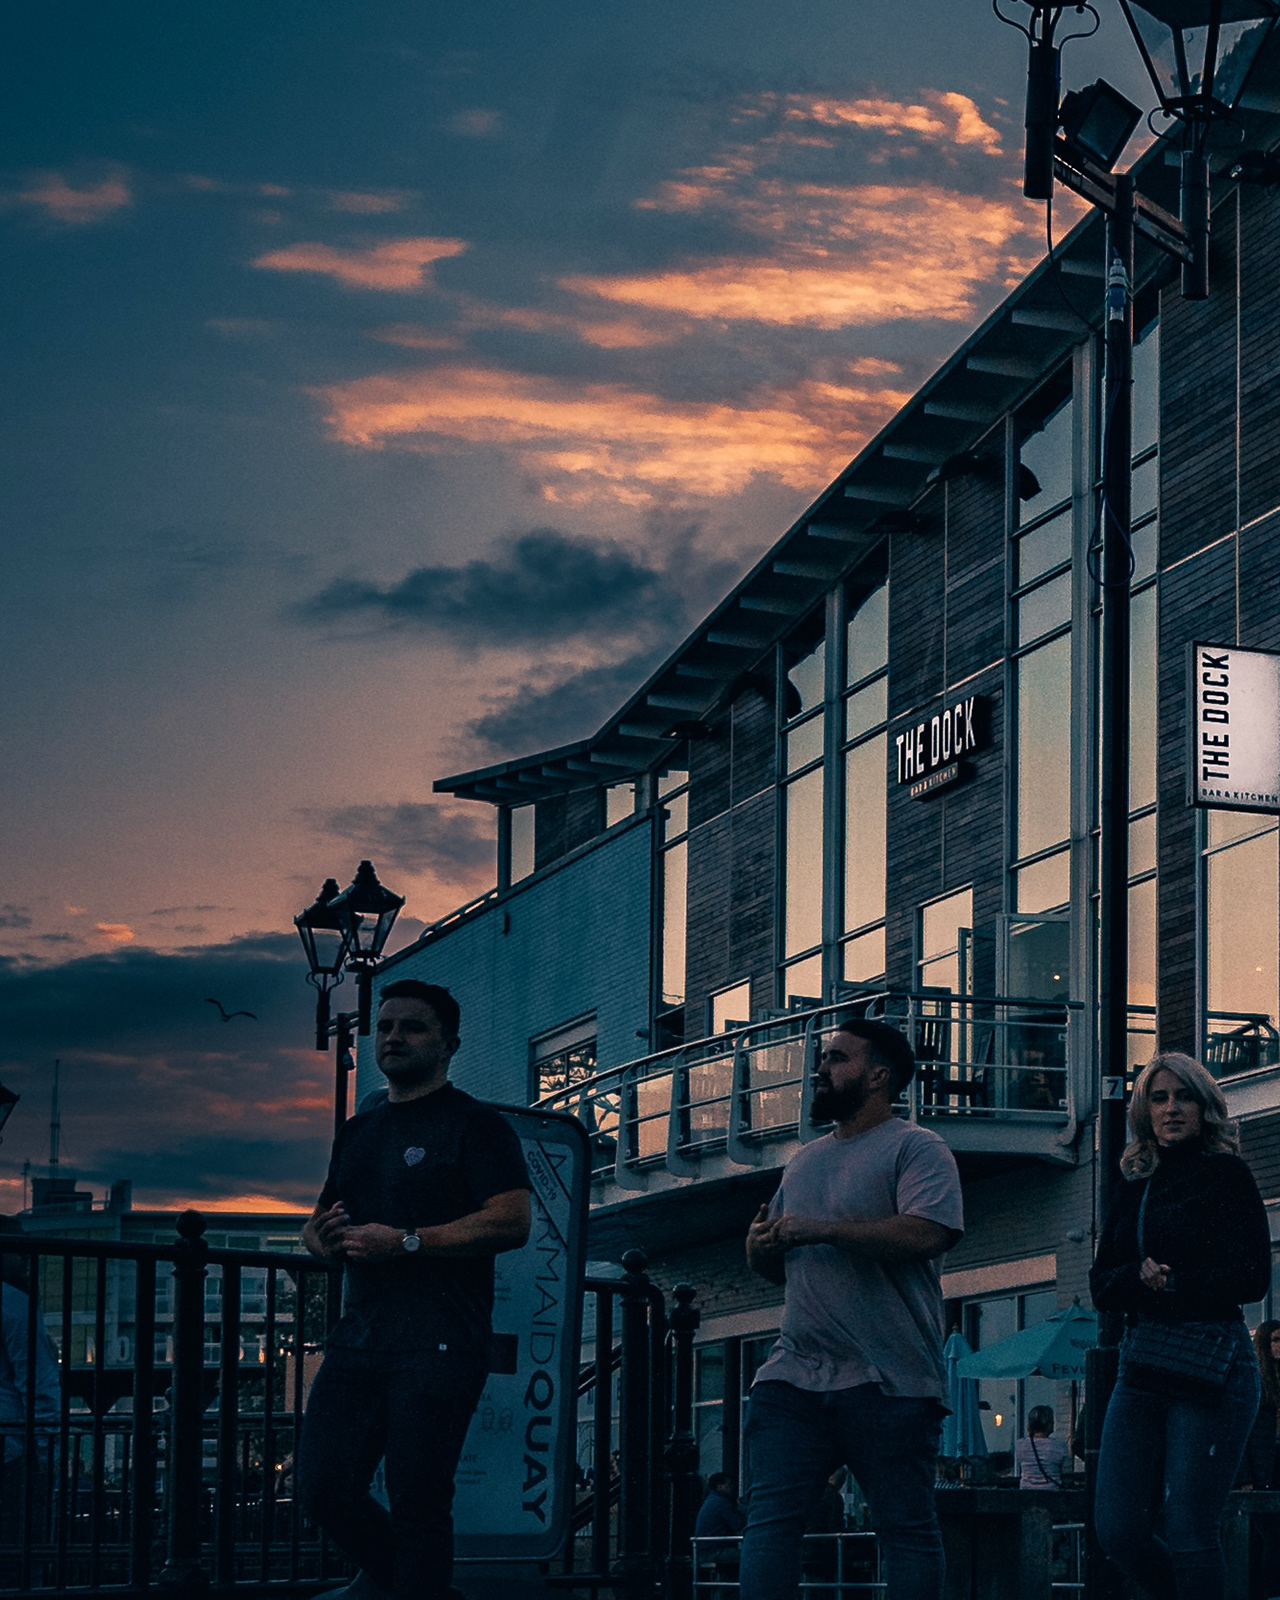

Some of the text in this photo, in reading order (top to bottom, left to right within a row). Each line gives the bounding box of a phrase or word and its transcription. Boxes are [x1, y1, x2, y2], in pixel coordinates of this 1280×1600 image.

[896, 696, 976, 784] THE DOCK
[1202, 652, 1229, 781] THE DOCK
[1202, 788, 1221, 797] BAR
[1234, 792, 1278, 803] KITCHEN
[1107, 1080, 1118, 1095] 7
[527, 1151, 557, 1201] COVID-19
